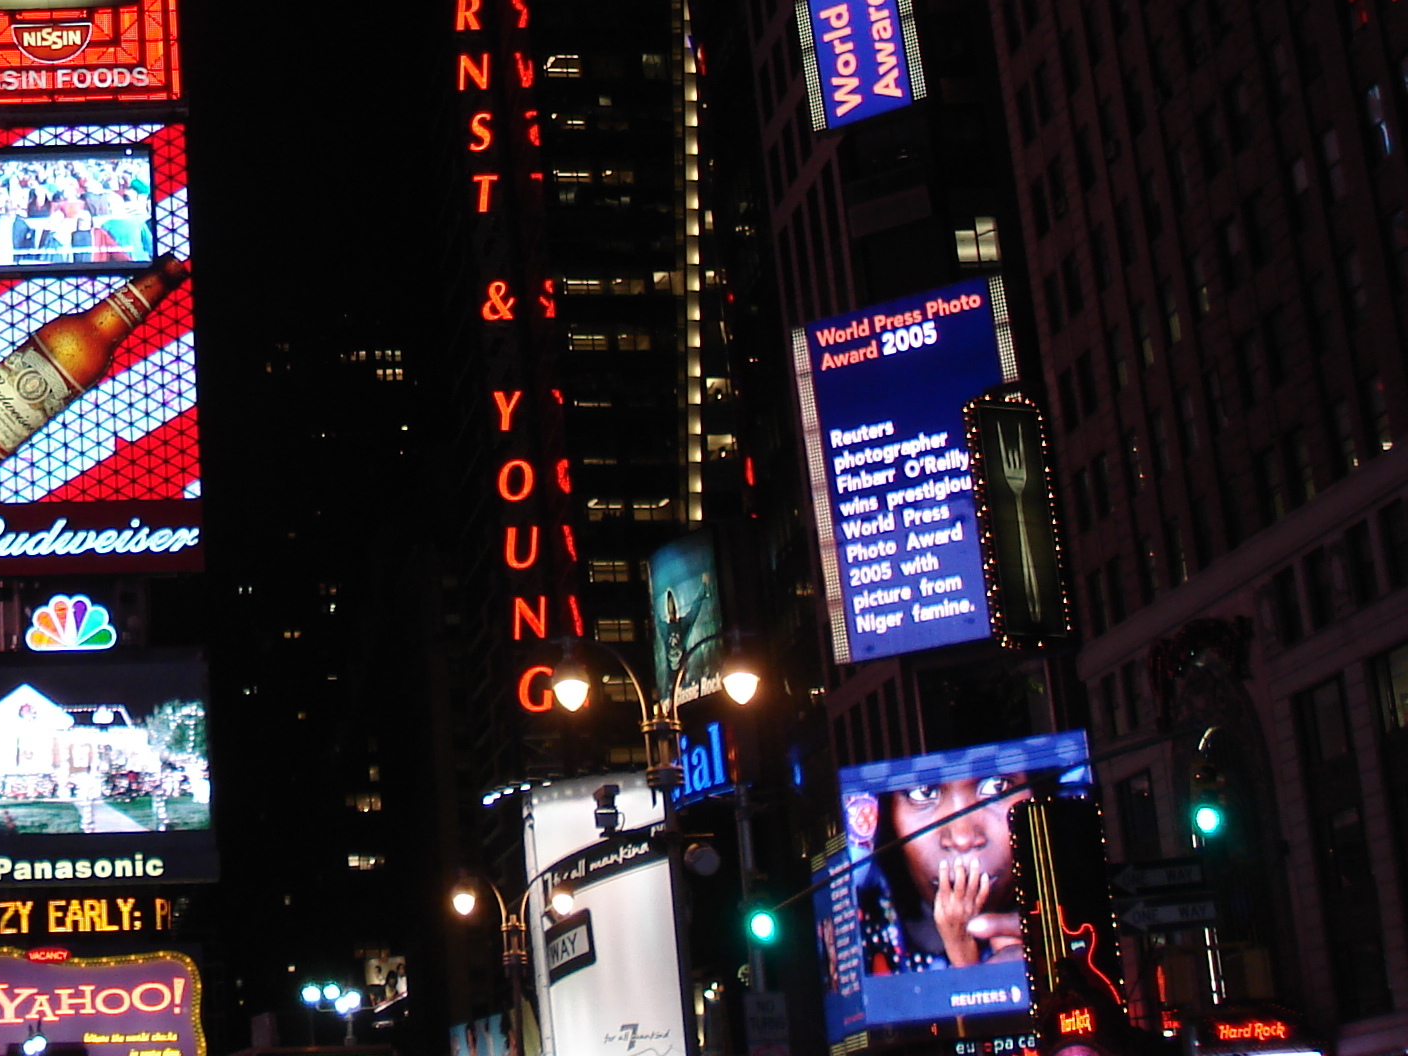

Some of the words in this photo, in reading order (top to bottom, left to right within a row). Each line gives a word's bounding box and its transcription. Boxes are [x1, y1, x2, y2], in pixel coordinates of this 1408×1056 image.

[23, 28, 82, 49] NISSIN
[819, 3, 863, 117] World
[57, 67, 149, 88] FOODS
[816, 318, 871, 347] World
[874, 308, 923, 334] Press
[926, 292, 982, 319] Photo
[821, 341, 878, 371] Award
[881, 321, 937, 355] 2005
[830, 420, 894, 449] Reuters
[833, 432, 947, 474] photographer
[836, 467, 895, 494] Finbarr
[904, 450, 969, 480] O'Reilly
[840, 491, 878, 517] wins
[887, 474, 972, 512] prestigiou
[842, 513, 895, 540] World
[903, 506, 950, 529] Press
[493, 390, 554, 713] YOUNG
[846, 541, 897, 564] Photo
[907, 522, 963, 551] Award
[850, 565, 892, 587] 2005
[900, 554, 938, 576] with
[853, 583, 911, 613] picture
[919, 574, 962, 598] from
[856, 608, 904, 635] Niger
[912, 598, 975, 624] famine.
[700, 671, 722, 697] Rock
[1166, 868, 1193, 881] WAY
[48, 897, 142, 932] EARLY;
[1132, 908, 1159, 922] ONE
[1178, 904, 1207, 918] WAY
[28, 951, 68, 961] VACANCY
[756, 1000, 775, 1012] NO
[950, 990, 1007, 1007] REUTERS
[1218, 1023, 1253, 1040] Hard
[1253, 1021, 1285, 1040] Rock
